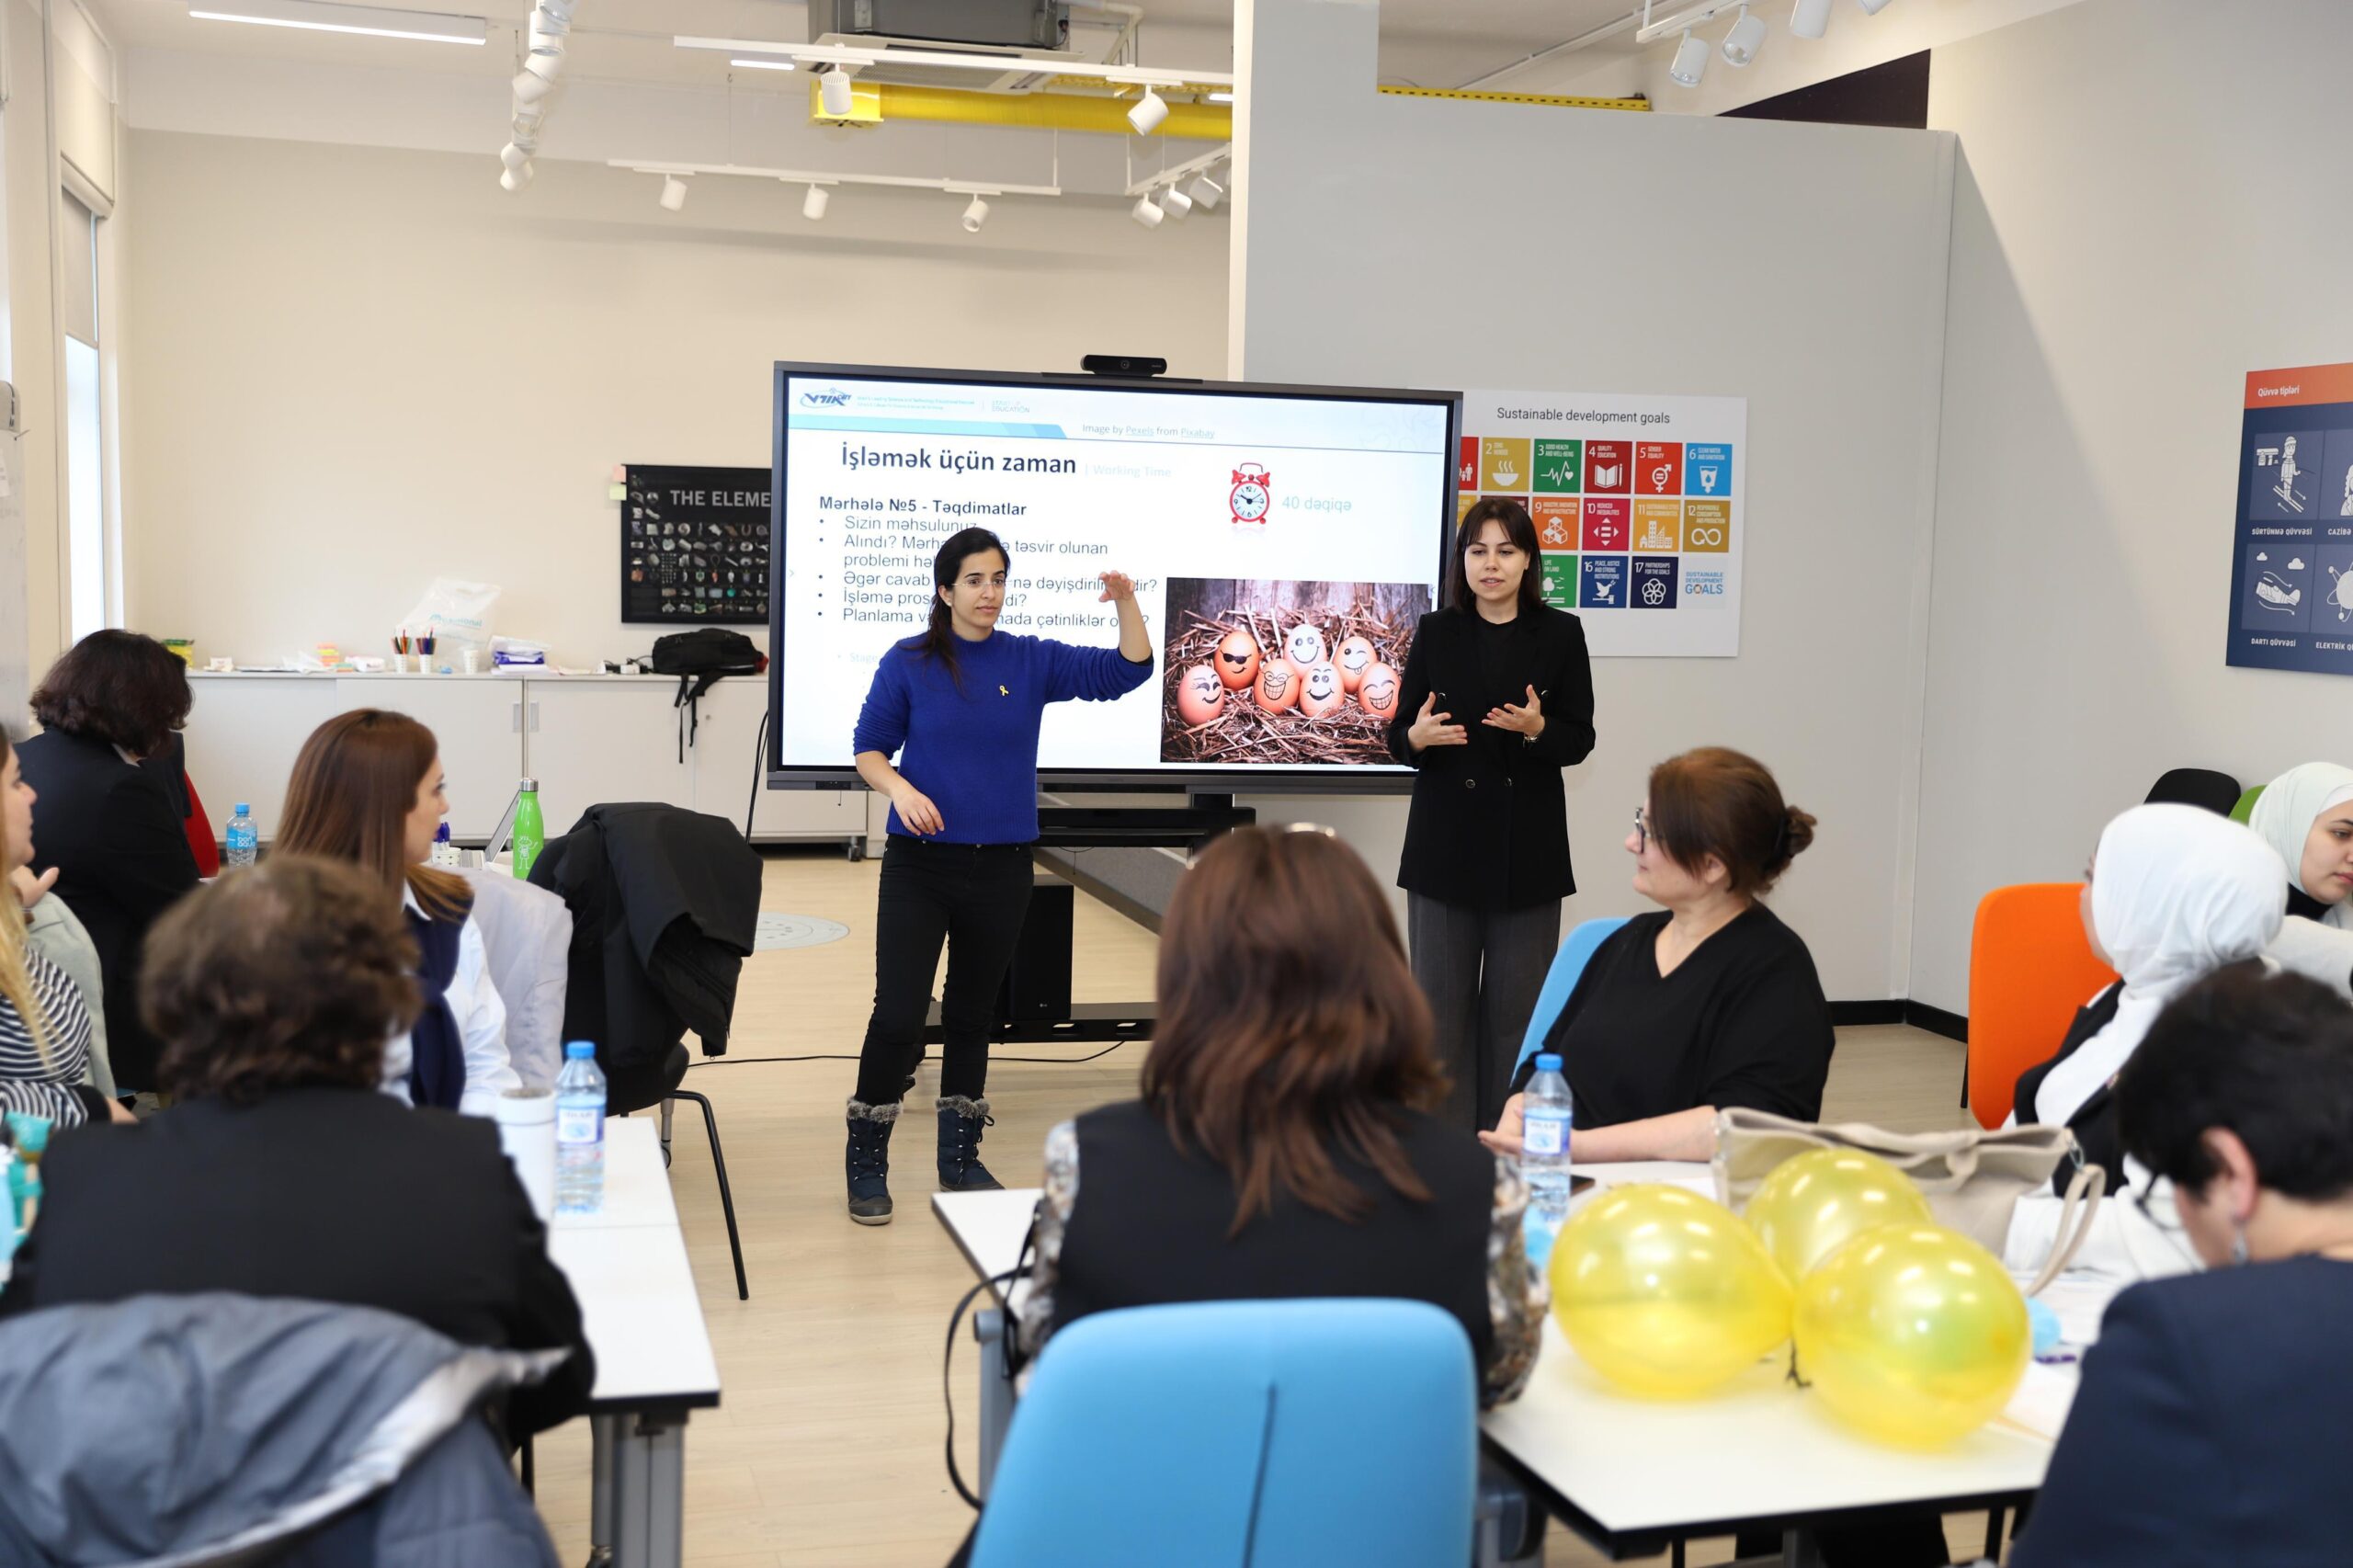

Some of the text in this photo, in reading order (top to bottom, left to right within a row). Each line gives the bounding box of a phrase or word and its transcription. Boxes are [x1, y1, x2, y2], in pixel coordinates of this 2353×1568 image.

[2257, 387, 2279, 397] Qüvvə
[1497, 407, 1670, 426] Sustainable development goals
[1082, 424, 1215, 439] Image by Pexels from Pixabay
[1485, 443, 1493, 454] 2
[1538, 445, 1545, 456] 3
[1589, 447, 1596, 457] 4
[1639, 448, 1646, 459] 5
[1689, 449, 1696, 460] 6
[842, 442, 1076, 474] İşləmək üçün zaman
[670, 490, 705, 506] THE
[819, 496, 884, 511] Mərhələ
[932, 500, 1027, 516] Təqdimatlar
[1282, 496, 1352, 514] 40 dəqiqə
[1535, 502, 1542, 513] 9
[1587, 503, 1596, 514] 10
[845, 516, 881, 530] Sizin
[844, 534, 897, 548] Alındı?
[1015, 540, 1055, 553] təsvir
[1059, 541, 1108, 554] olunan
[844, 554, 909, 568] problemi
[1585, 561, 1593, 572] 16
[1635, 562, 1644, 573] 17
[844, 571, 881, 588] Əgər
[886, 574, 930, 586] cavab
[1685, 584, 1723, 594] GOALS
[844, 587, 892, 605] İşləmə
[843, 608, 913, 623] Planlama
[1037, 614, 1105, 629] çətinliklər
[2316, 641, 2345, 650] ELEKTRİK
